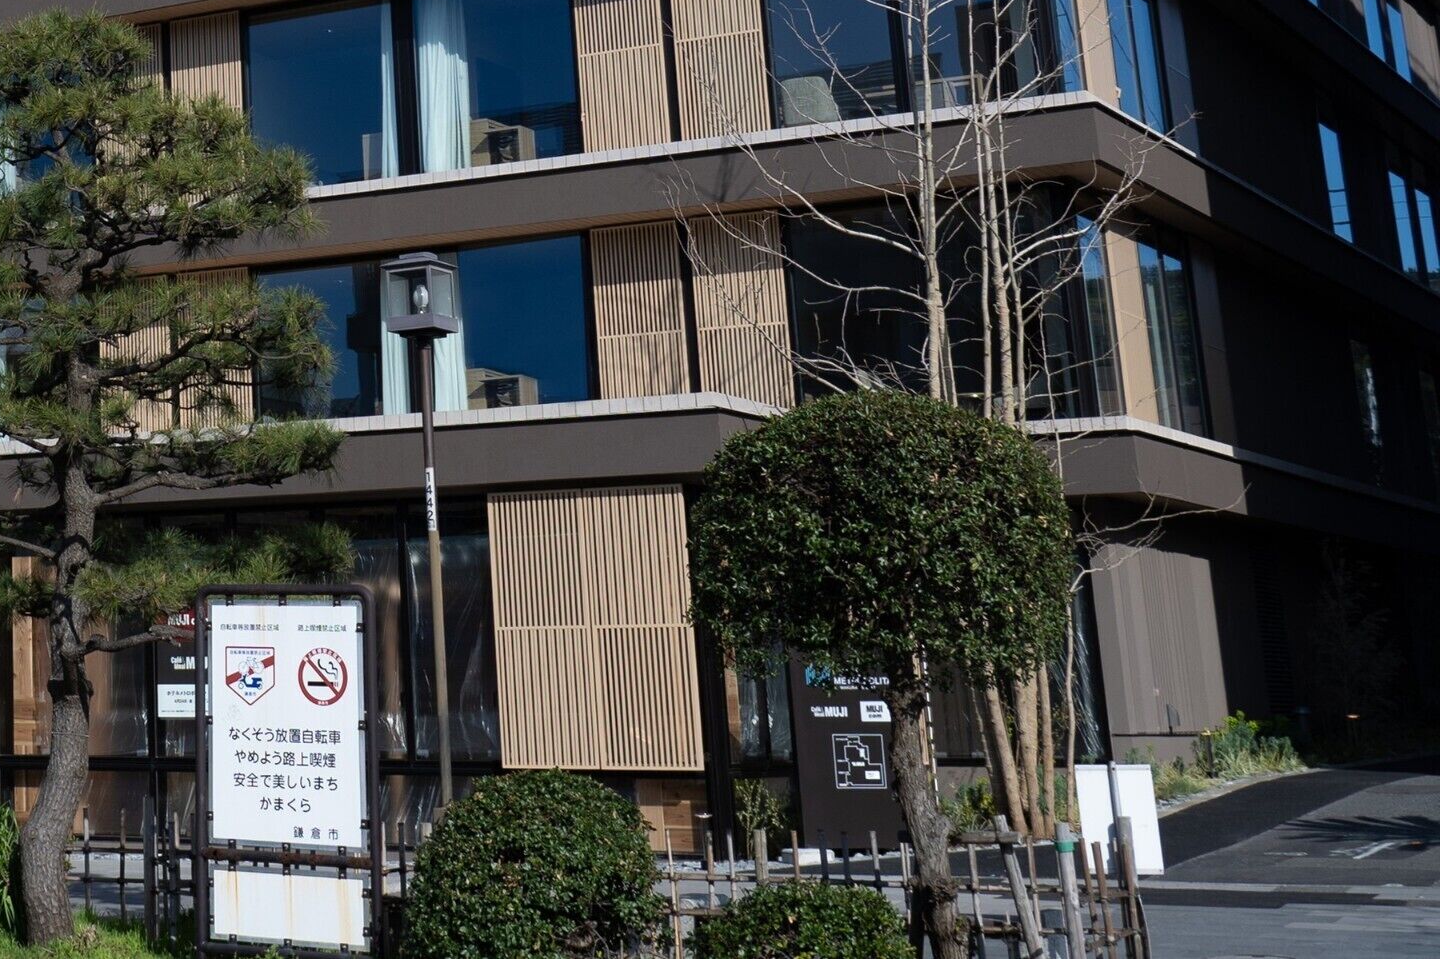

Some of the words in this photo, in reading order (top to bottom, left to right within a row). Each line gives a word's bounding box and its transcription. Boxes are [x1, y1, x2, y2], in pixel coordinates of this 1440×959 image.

[425, 472, 435, 522] 1442
[824, 706, 848, 717] MUJI
[866, 704, 884, 713] MUJI
[228, 726, 341, 745] なくそう放置自転車
[234, 749, 337, 769] やめよう路上喫煙
[233, 772, 338, 791] 安全で美しいまち
[260, 796, 311, 813] かまくら
[293, 826, 339, 840] 鎌倉市
